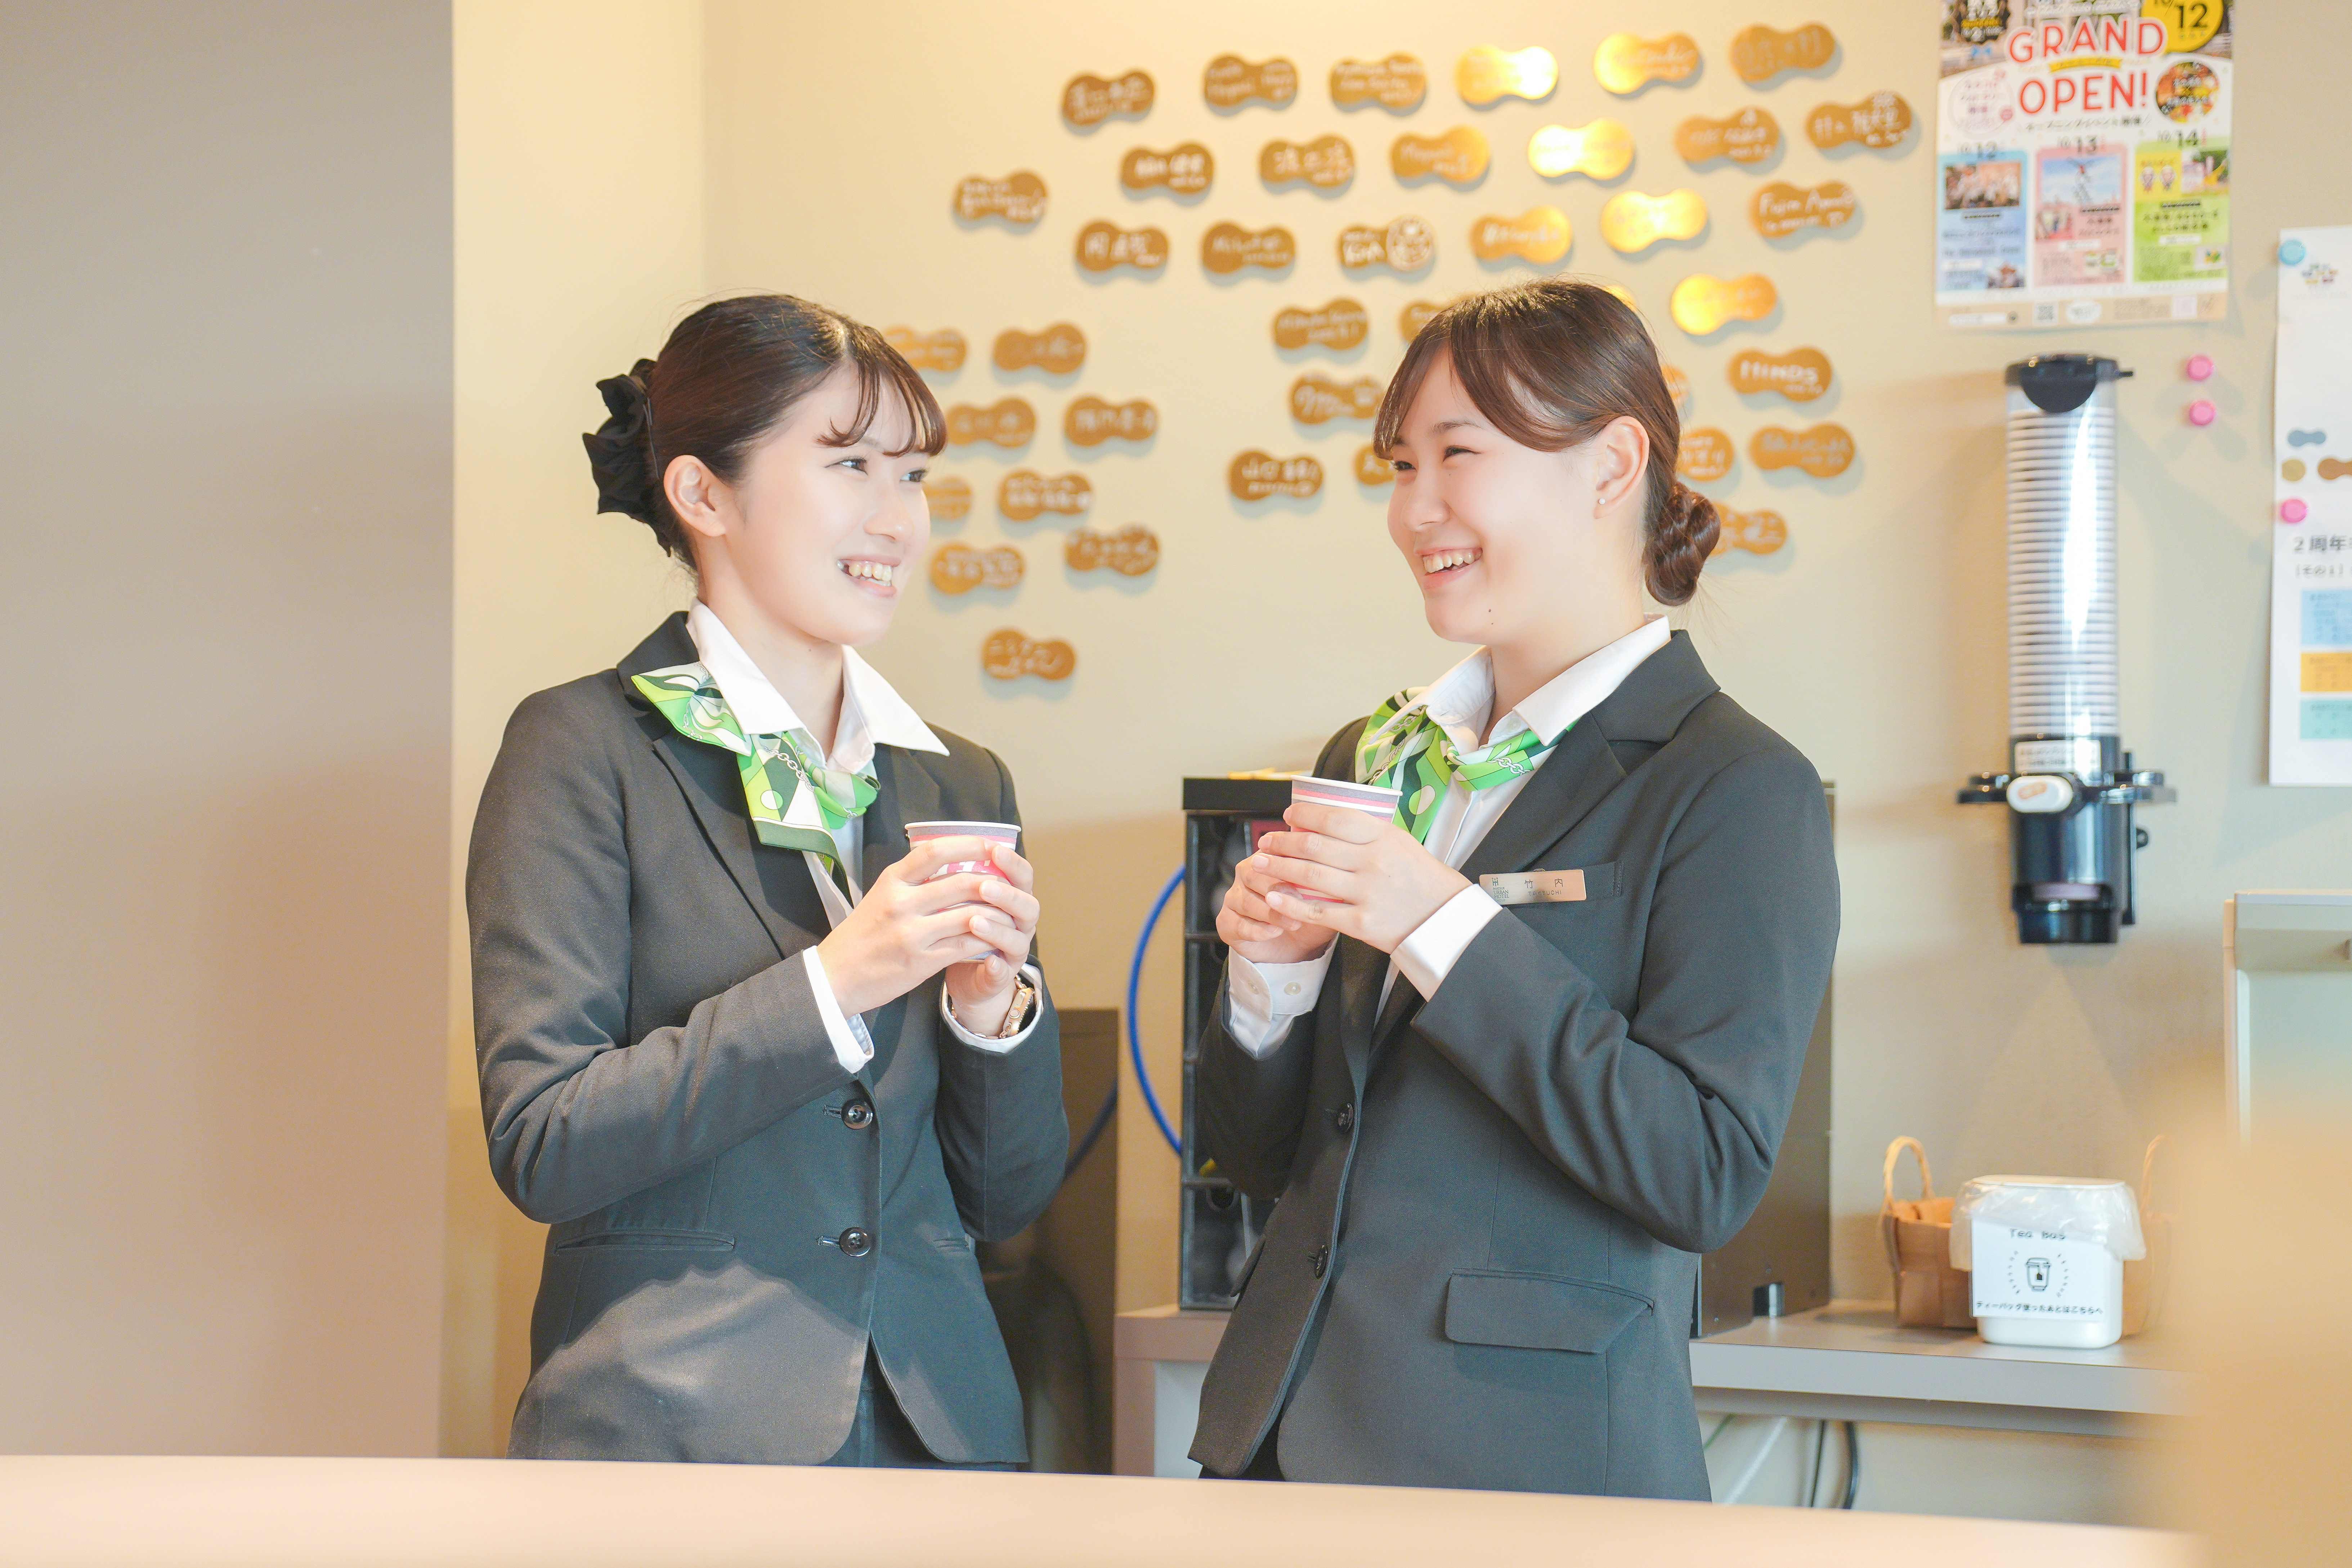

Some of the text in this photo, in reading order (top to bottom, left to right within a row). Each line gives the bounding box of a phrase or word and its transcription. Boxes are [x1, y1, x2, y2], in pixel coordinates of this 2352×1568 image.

[2010, 20, 2163, 63] GRAND
[2020, 72, 2147, 114] OPEN!
[2293, 534, 2352, 551] 2周年
[2010, 1228, 2033, 1239] Tea
